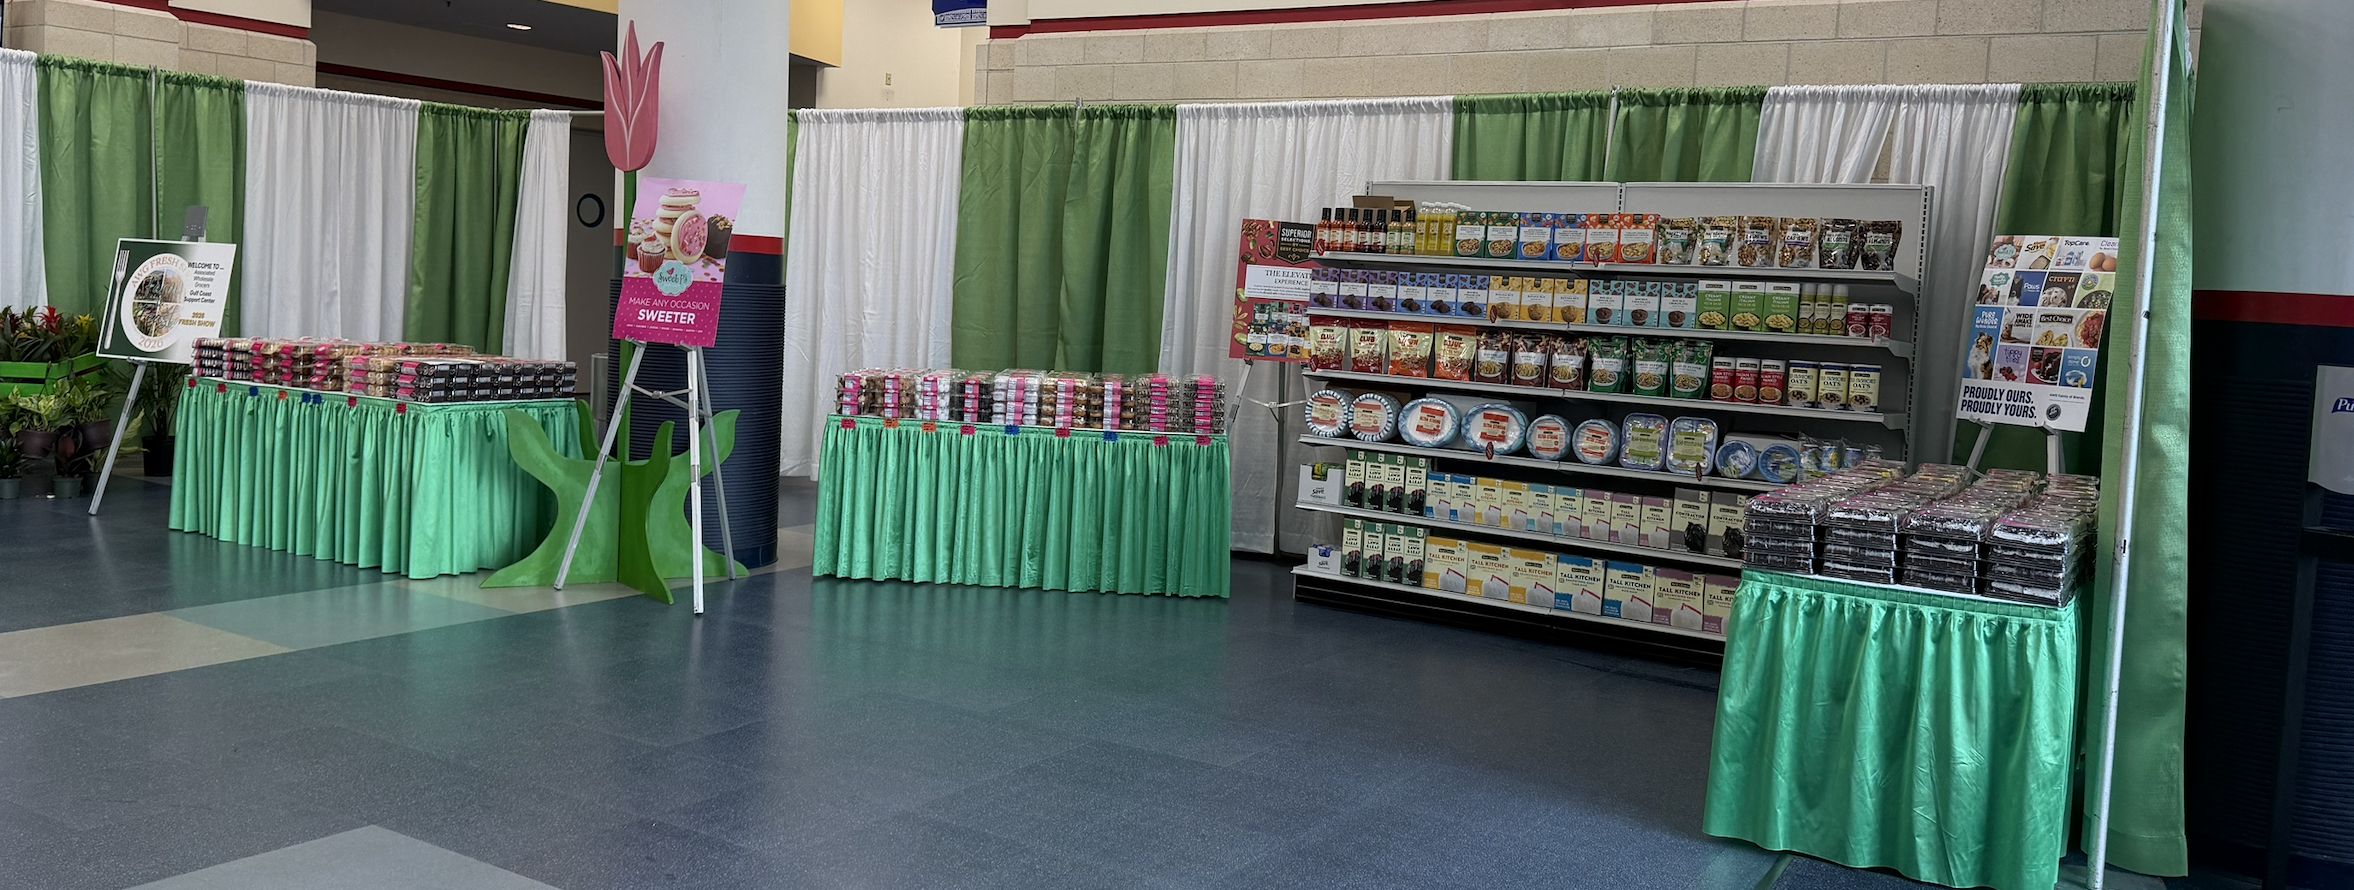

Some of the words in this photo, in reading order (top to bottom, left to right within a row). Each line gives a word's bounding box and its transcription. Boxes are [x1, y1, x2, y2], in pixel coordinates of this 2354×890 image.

[1282, 228, 1312, 238] SUPERIOR
[132, 264, 149, 287] AWG
[150, 256, 179, 268] FRESH
[628, 297, 650, 307] MAKE
[652, 299, 669, 308] ANY
[670, 300, 710, 310] OCCASION
[638, 309, 696, 324] SWEETER
[138, 336, 163, 348] 2026
[1963, 386, 2005, 400] PROUDLY
[2006, 389, 2033, 404] OURS.
[1960, 400, 2002, 415] PROUDLY
[2004, 403, 2036, 419] YOURS.
[1624, 580, 1651, 588] KITCHEN
